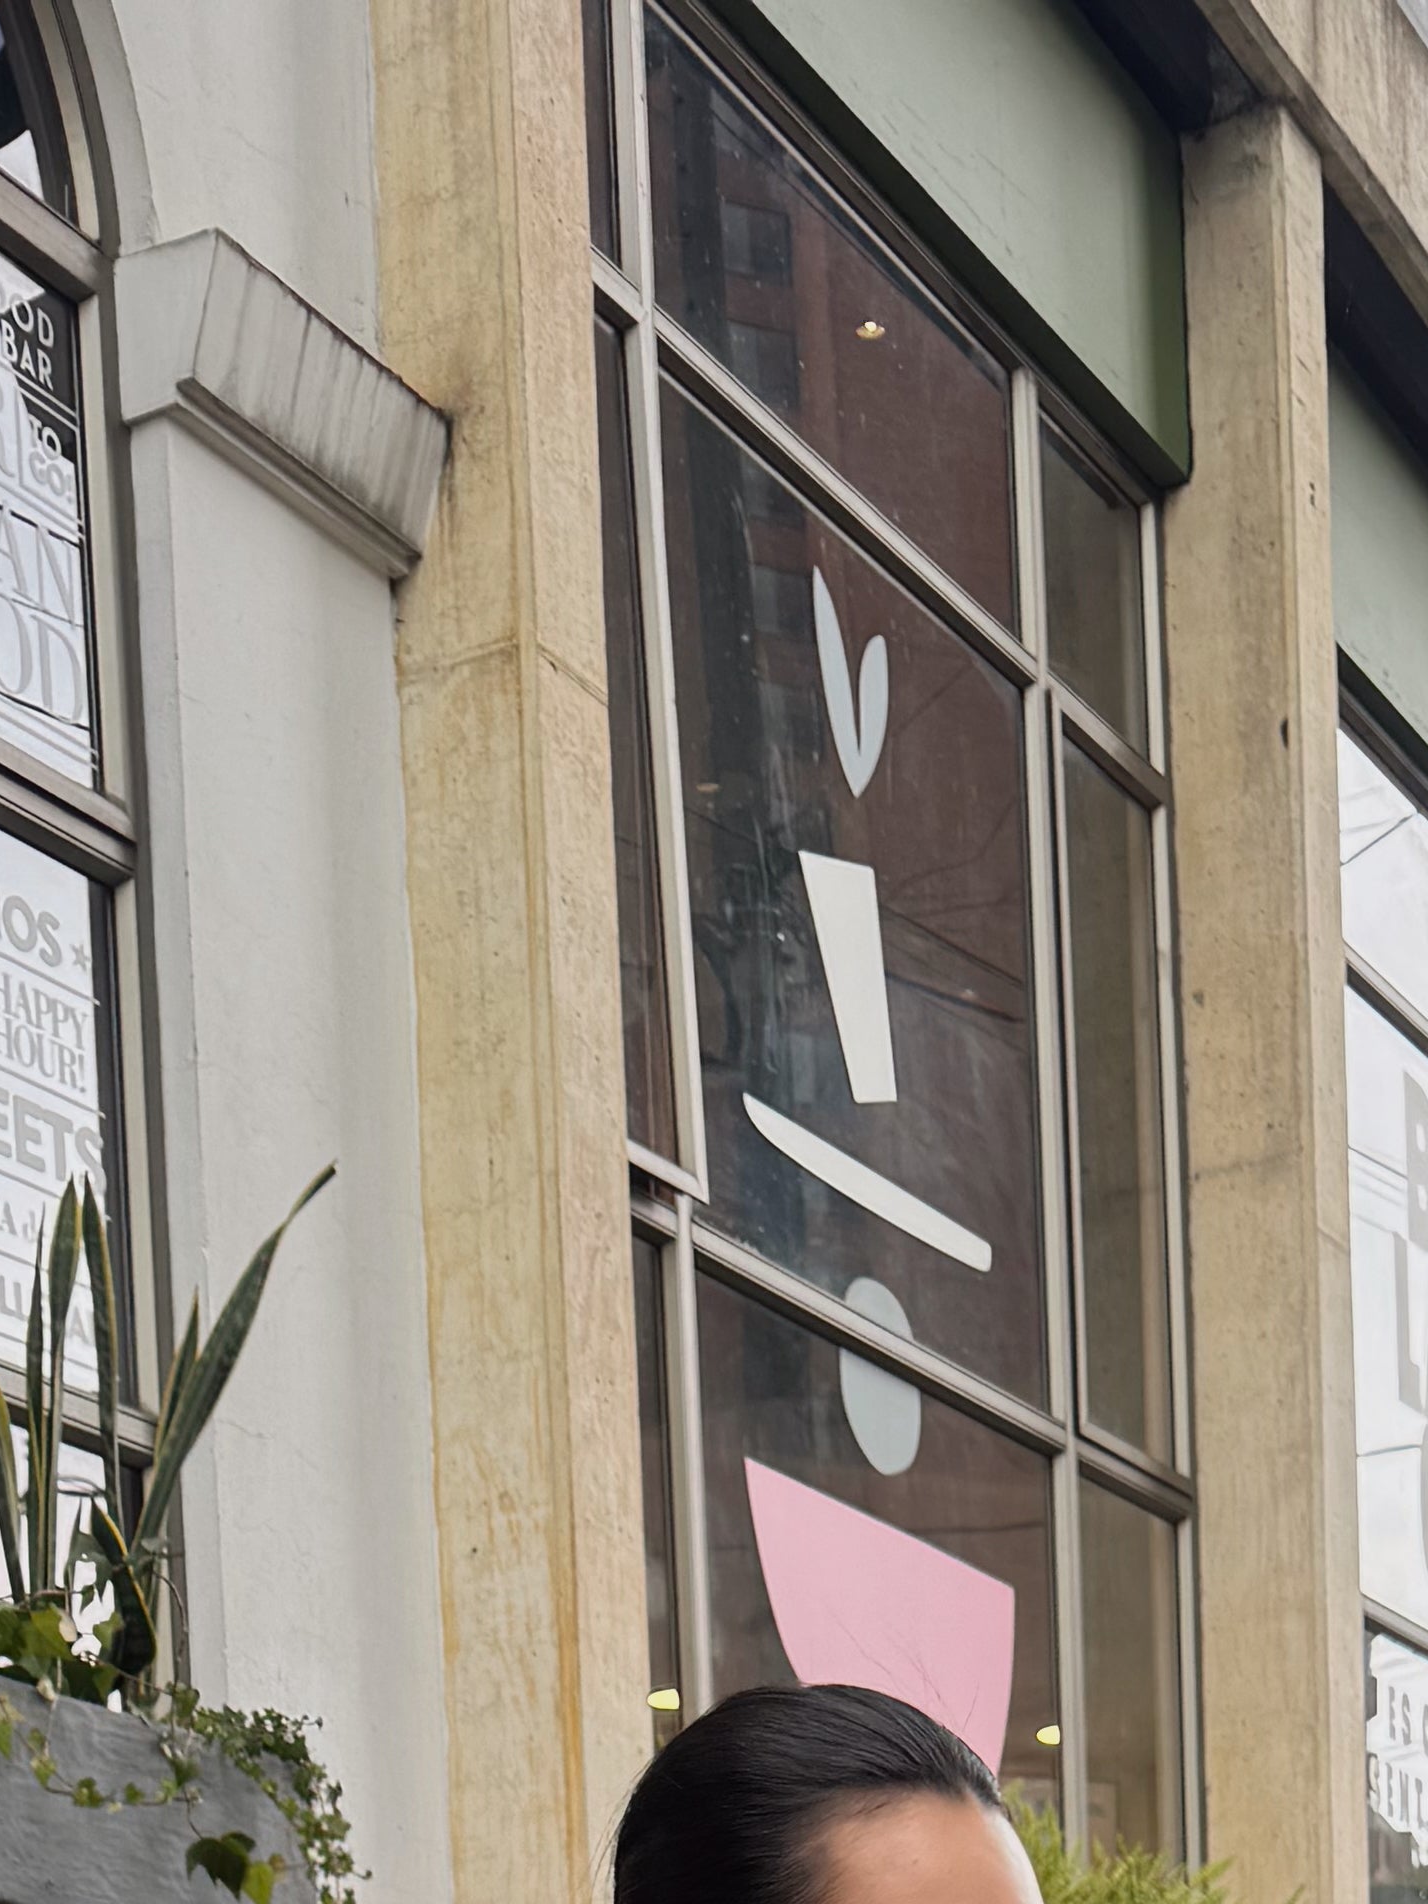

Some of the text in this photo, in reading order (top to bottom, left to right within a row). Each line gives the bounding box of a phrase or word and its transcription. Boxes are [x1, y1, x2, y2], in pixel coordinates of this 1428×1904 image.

[0, 318, 54, 391] BAR
[27, 413, 62, 461] TO
[1388, 1686, 1412, 1746] ES
